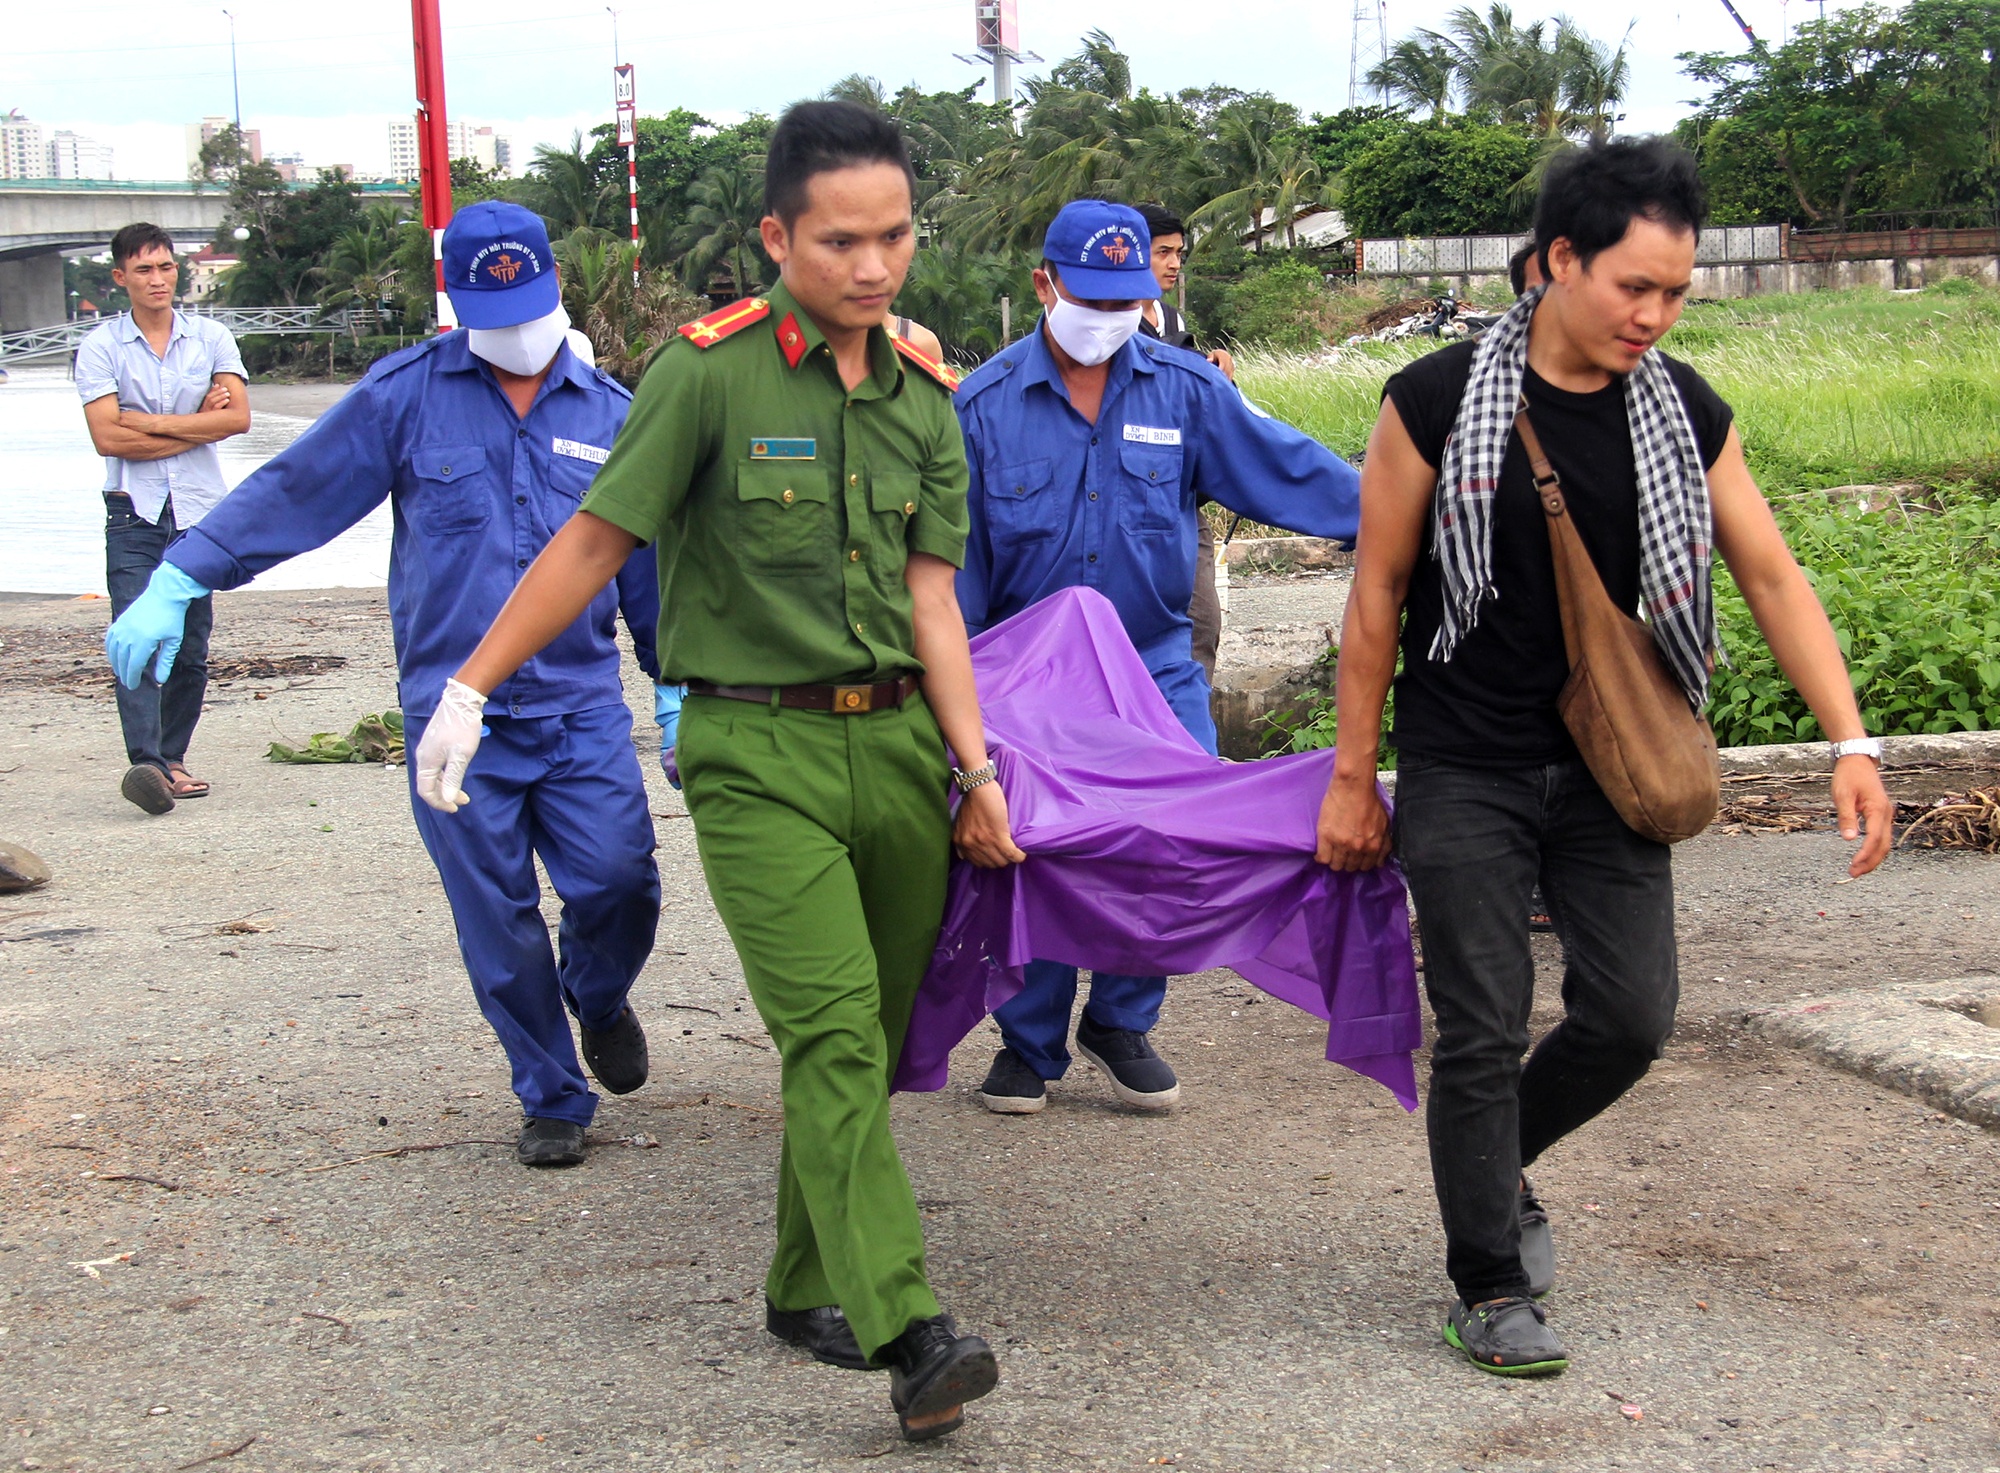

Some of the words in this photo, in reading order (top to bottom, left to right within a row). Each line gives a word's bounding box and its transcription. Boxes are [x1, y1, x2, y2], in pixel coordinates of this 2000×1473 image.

[619, 83, 630, 97] 8.0
[1094, 228, 1106, 239] MTV
[477, 248, 489, 260] MTV
